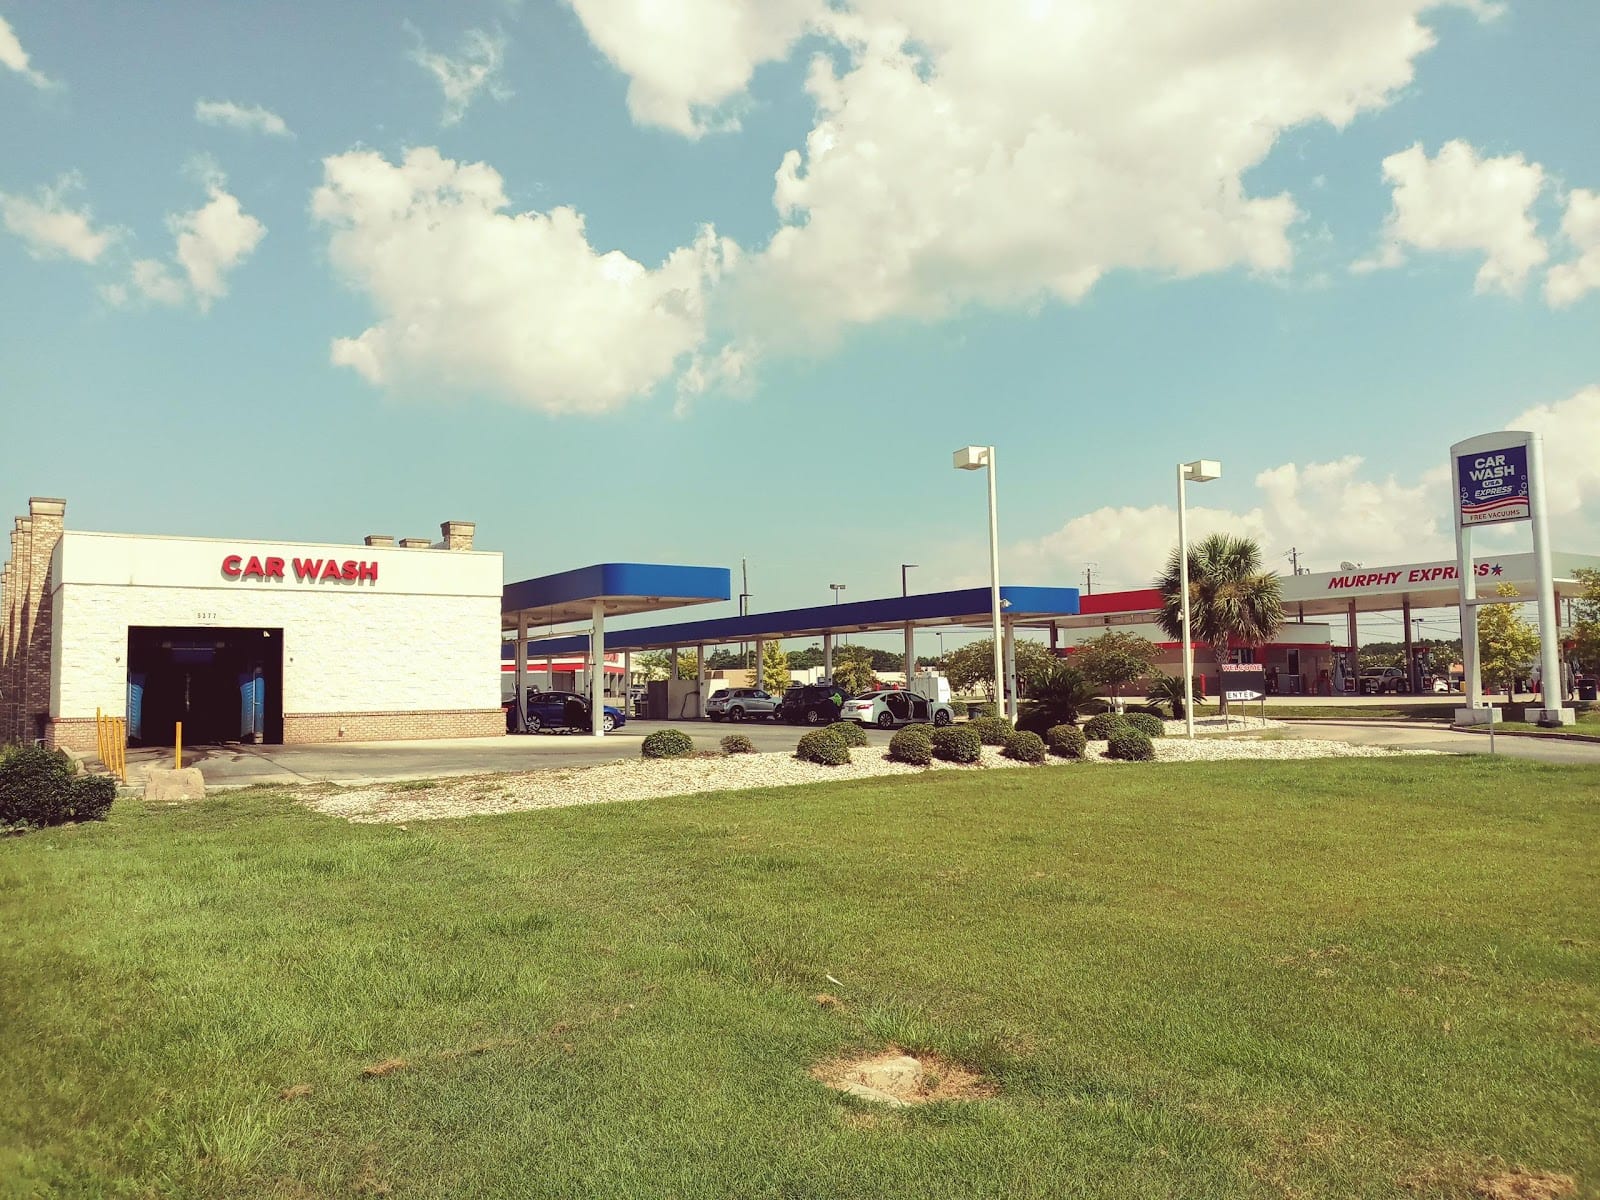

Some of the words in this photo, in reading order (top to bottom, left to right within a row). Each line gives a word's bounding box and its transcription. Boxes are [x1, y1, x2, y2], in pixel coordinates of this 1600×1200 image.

[1474, 454, 1506, 469] CAR
[1469, 465, 1515, 481] WASH
[1475, 485, 1513, 497] EXPRESS
[1470, 513, 1487, 521] FREE
[1488, 509, 1521, 518] VACUUMS
[222, 554, 286, 578] CAR
[292, 557, 379, 581] WASH
[1327, 571, 1403, 590] MURPHY
[1408, 563, 1490, 583] EXPRS
[1221, 663, 1263, 672] WELCOME
[1227, 691, 1254, 699] ENTER
